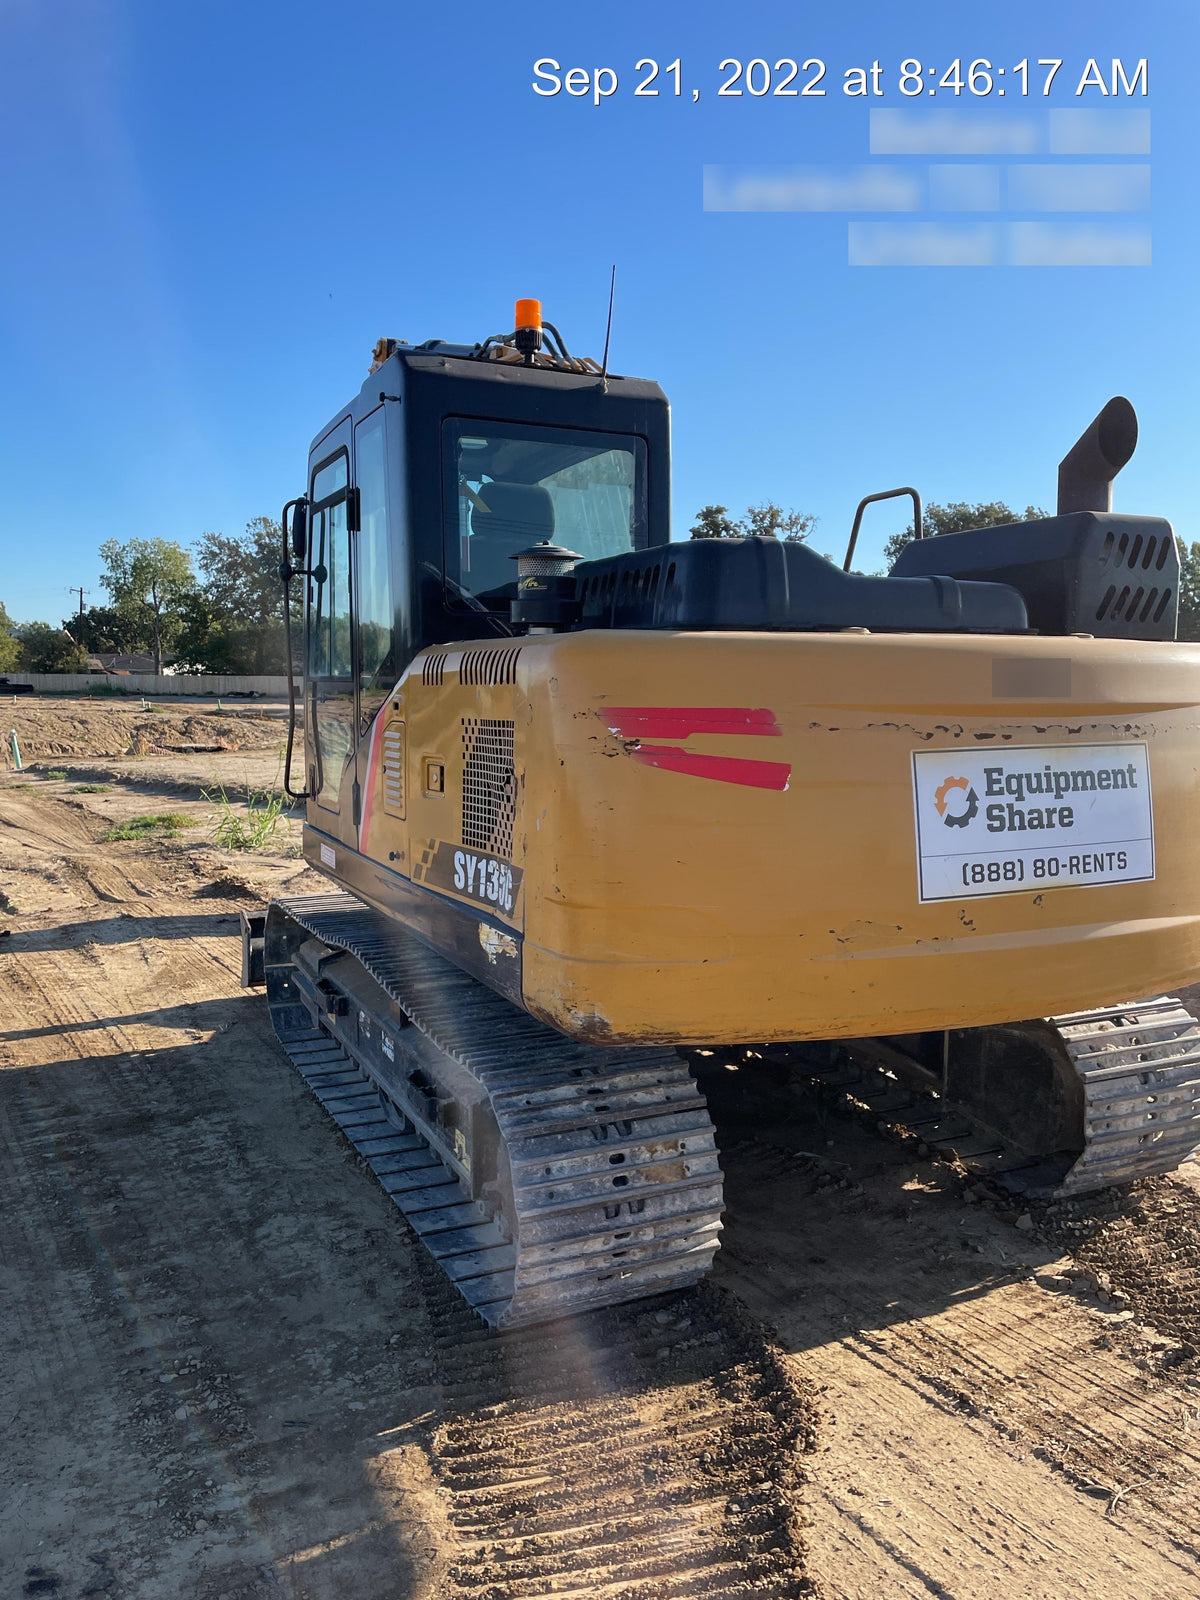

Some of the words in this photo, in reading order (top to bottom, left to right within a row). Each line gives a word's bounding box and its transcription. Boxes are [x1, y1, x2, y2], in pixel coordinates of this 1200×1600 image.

[984, 764, 1138, 801] Equipment
[986, 803, 1074, 833] Share
[962, 859, 1025, 886] (888)
[1033, 851, 1128, 878] 80-RENTS
